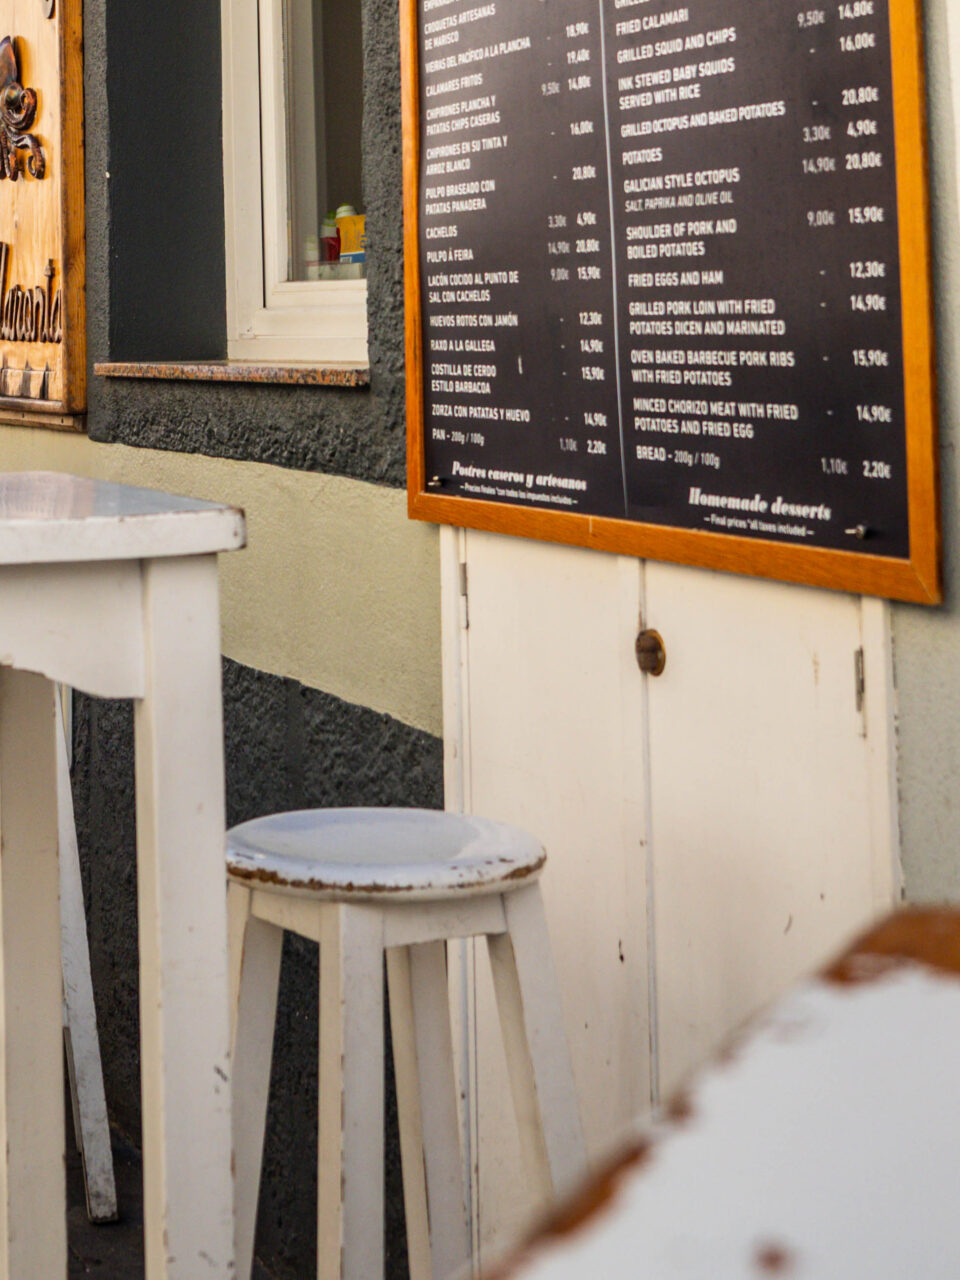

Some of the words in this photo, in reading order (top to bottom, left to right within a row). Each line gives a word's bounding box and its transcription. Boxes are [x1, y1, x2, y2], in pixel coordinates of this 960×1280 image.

[615, 18, 641, 35] FRIED
[642, 8, 688, 29] CALAMARI
[616, 44, 653, 63] GRILLED
[654, 38, 683, 55] SQUID
[684, 33, 704, 49] AND
[705, 26, 736, 45] CHIPS
[617, 76, 633, 90] INK
[634, 69, 671, 87] STEWED
[672, 64, 696, 81] BABY
[698, 57, 734, 76] SQUIDS
[619, 92, 652, 109] SERVED
[653, 88, 677, 103] WITH
[678, 83, 700, 99] RICE
[620, 120, 653, 137] GRILLED
[650, 115, 689, 132] OCTOPUS
[688, 112, 709, 127] AND
[706, 107, 739, 124] BAKED
[737, 100, 785, 119] POTATOES
[846, 119, 876, 136] 4,90€
[621, 147, 662, 164] POTATOES
[623, 176, 663, 192] GALICIAN
[664, 172, 692, 188] STYLE
[694, 167, 739, 185] OCTOPUS
[425, 225, 457, 238] CACHELOS
[626, 223, 671, 239] SHOULDER
[672, 222, 685, 236] OF
[687, 220, 713, 235] PORK
[715, 218, 736, 233] AND
[626, 244, 657, 259] BOILED
[658, 241, 704, 256] POTATOES
[628, 272, 653, 286] FRIED
[654, 271, 678, 286] EGGS
[680, 270, 699, 285] AND
[701, 270, 723, 284] HAM
[849, 261, 884, 278] 12,30€
[628, 301, 665, 315] GRILLED
[666, 300, 691, 314] PORK
[692, 300, 715, 314] LOIN
[716, 299, 742, 313] WITH
[744, 298, 775, 314] FRIED
[629, 320, 672, 334] POTATOES
[703, 320, 724, 334] AND
[726, 319, 785, 335] MARINATED
[630, 349, 653, 363] OVEN
[654, 349, 685, 364] BAKED
[686, 350, 736, 365] BARBECUE
[739, 350, 767, 365] PORK
[769, 351, 794, 366] RIBS
[852, 349, 887, 366] 15,90€
[431, 363, 461, 375] COSTILLA
[462, 364, 472, 376] DE
[473, 364, 496, 376] CERDO
[631, 368, 653, 382] WITH
[655, 369, 681, 384] FRIED
[683, 370, 731, 385] POTATOES
[431, 379, 453, 392] ESTILO
[454, 380, 490, 393] BARBACOA
[633, 397, 666, 412] MINCED
[667, 399, 708, 414] CHORIZO
[709, 401, 735, 416] MEAT
[737, 402, 764, 417] WITH
[766, 403, 798, 419] FRIED
[634, 416, 678, 432] POTATOES
[680, 420, 700, 434] AND
[701, 420, 731, 436] FRIED
[732, 422, 753, 438] EGG
[635, 445, 665, 461] BREAD
[674, 449, 693, 466] 200g
[700, 452, 719, 469] 100g
[451, 460, 486, 478] Postres
[487, 469, 524, 482] caseros
[525, 473, 533, 488] y
[535, 474, 586, 490] artesanos
[862, 460, 890, 478] 2,20€
[688, 487, 767, 511] Homemade
[770, 496, 830, 519] desserts
